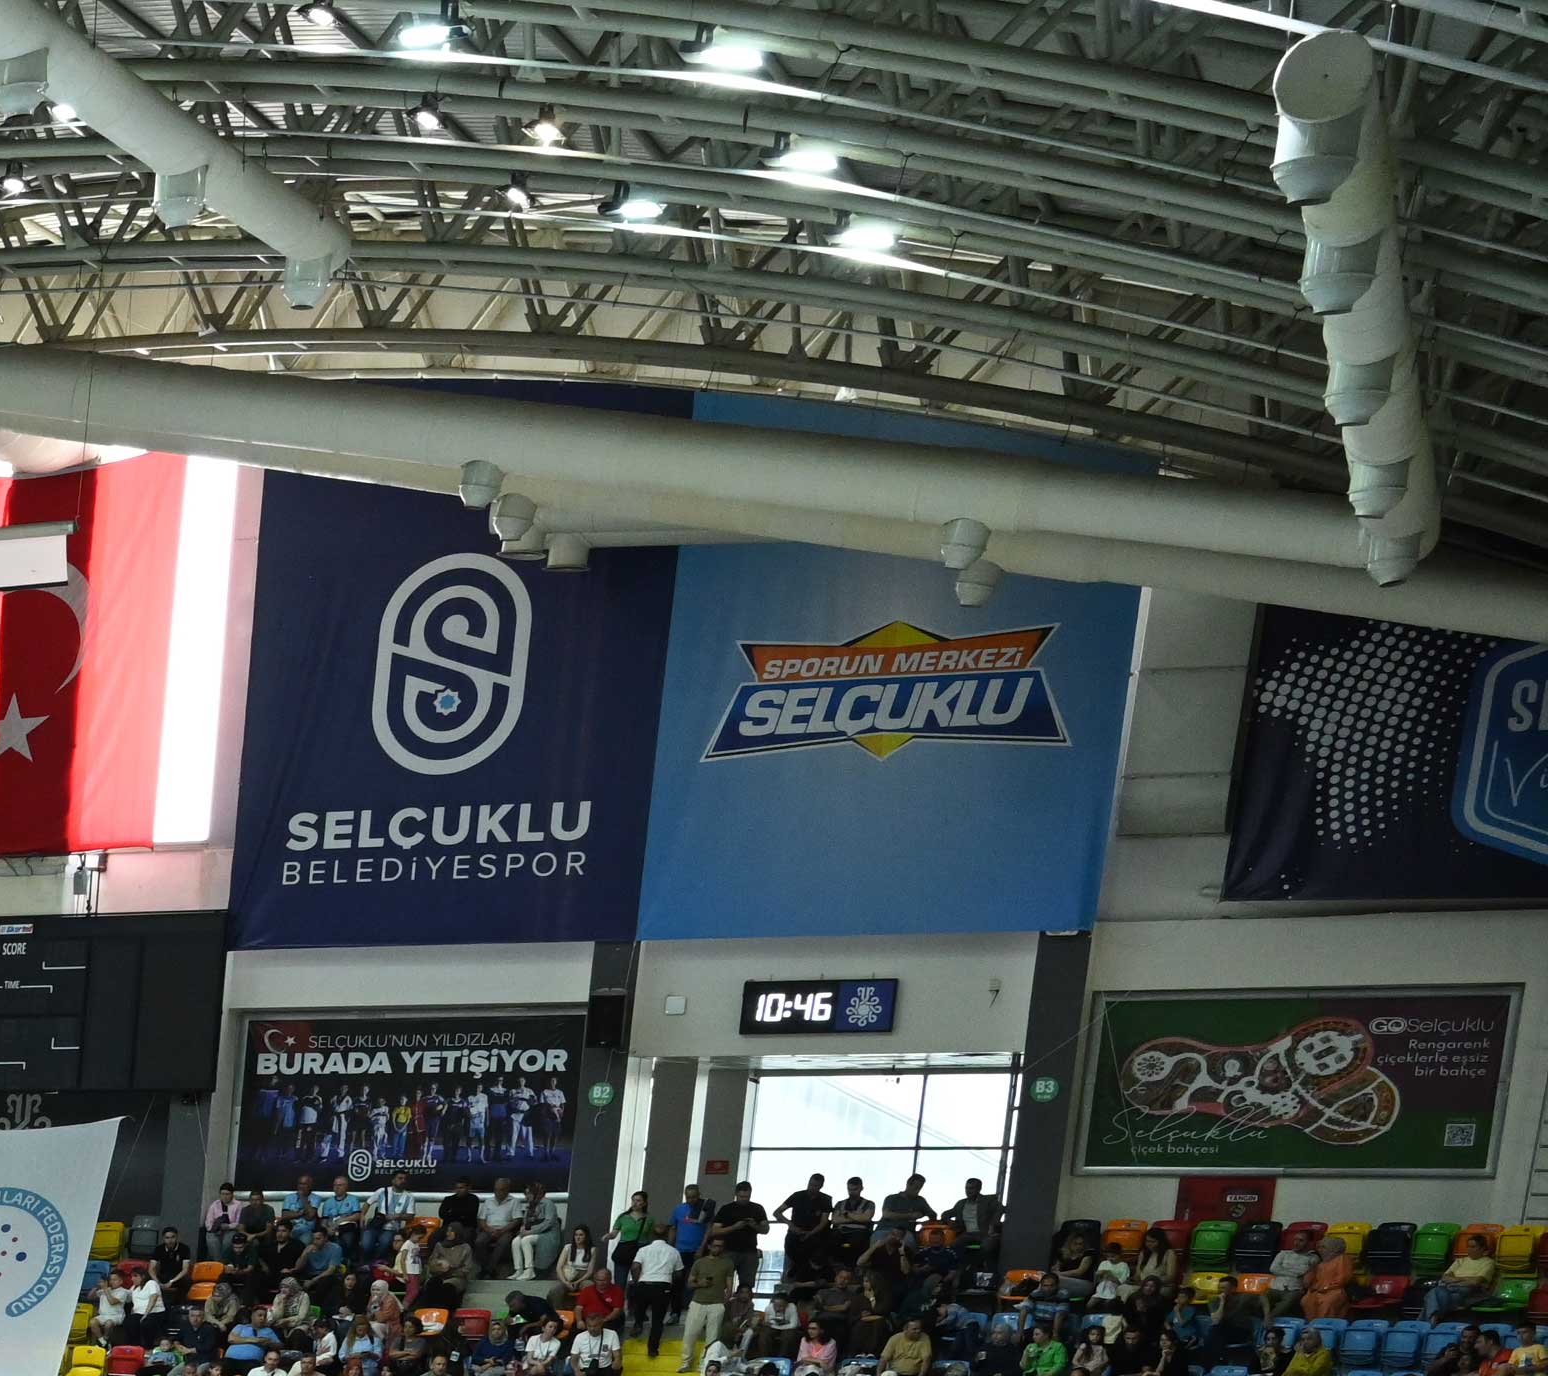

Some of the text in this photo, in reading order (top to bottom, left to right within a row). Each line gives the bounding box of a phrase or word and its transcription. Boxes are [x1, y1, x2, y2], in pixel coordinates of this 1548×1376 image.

[762, 654, 884, 681] SPORUN
[738, 677, 1034, 739] SELÇUKLU
[286, 800, 591, 851] SELÇUKLU
[2, 942, 27, 956] SCORE
[755, 992, 833, 1022] 10:46
[308, 1032, 516, 1051] SELÇUKLU'NUN YILDIZLARI
[1409, 1038, 1490, 1052] Rengarenk
[256, 1051, 394, 1075] BURADA
[1377, 1052, 1489, 1066] çiçeklerle eşsiz
[1415, 1066, 1486, 1079] bir bahçe
[593, 1086, 610, 1098] B2
[1036, 1081, 1054, 1093] B3
[1167, 1144, 1219, 1156] bahçesi
[10, 1206, 66, 1314] FEDERASYONU
